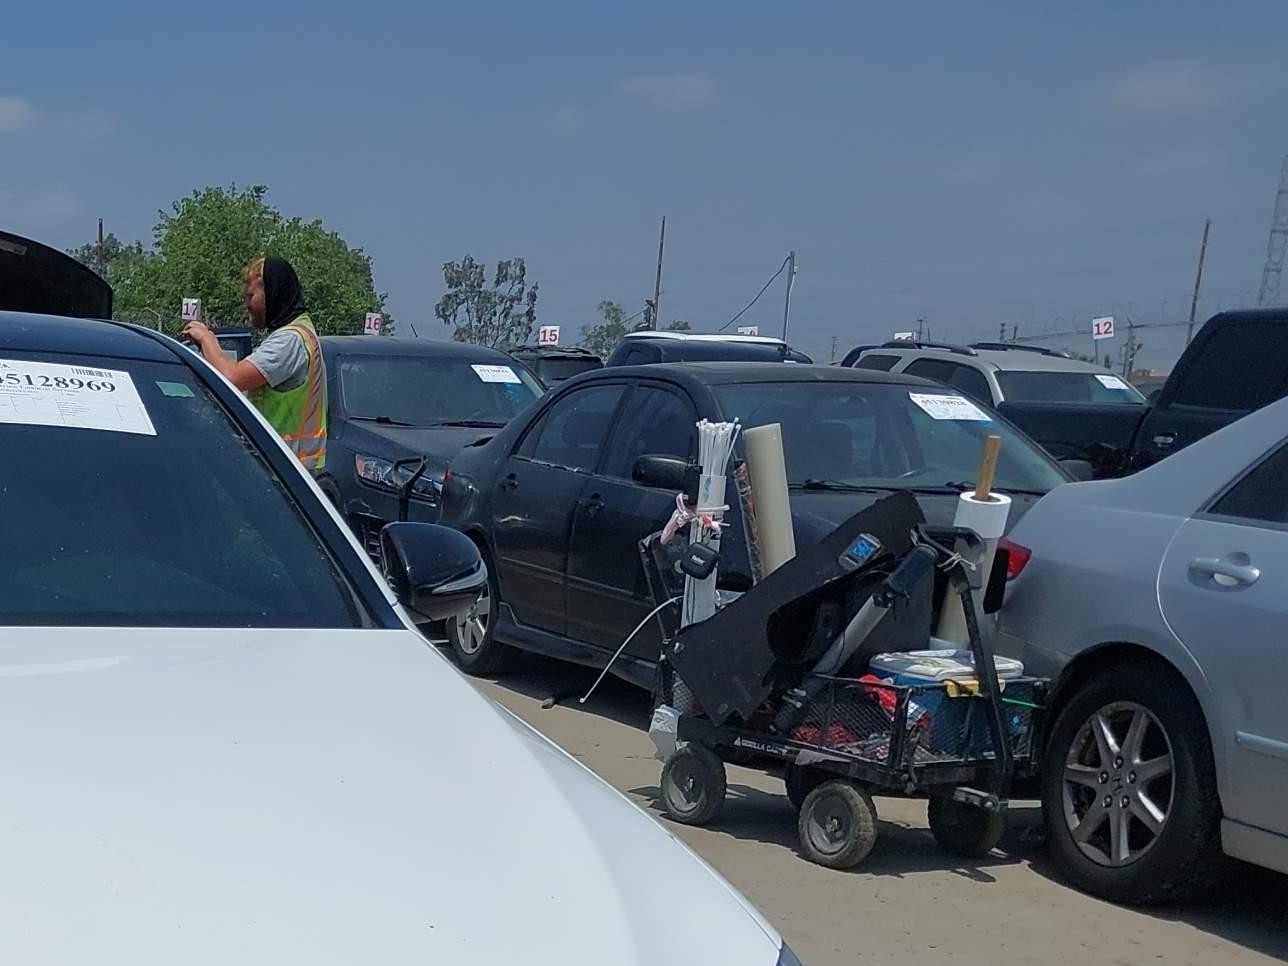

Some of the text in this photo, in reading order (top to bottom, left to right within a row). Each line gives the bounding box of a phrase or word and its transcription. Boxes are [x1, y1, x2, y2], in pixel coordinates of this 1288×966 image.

[183, 302, 198, 316] 17
[366, 316, 381, 331] 16
[1094, 321, 1113, 336] 12
[540, 329, 558, 343] 15
